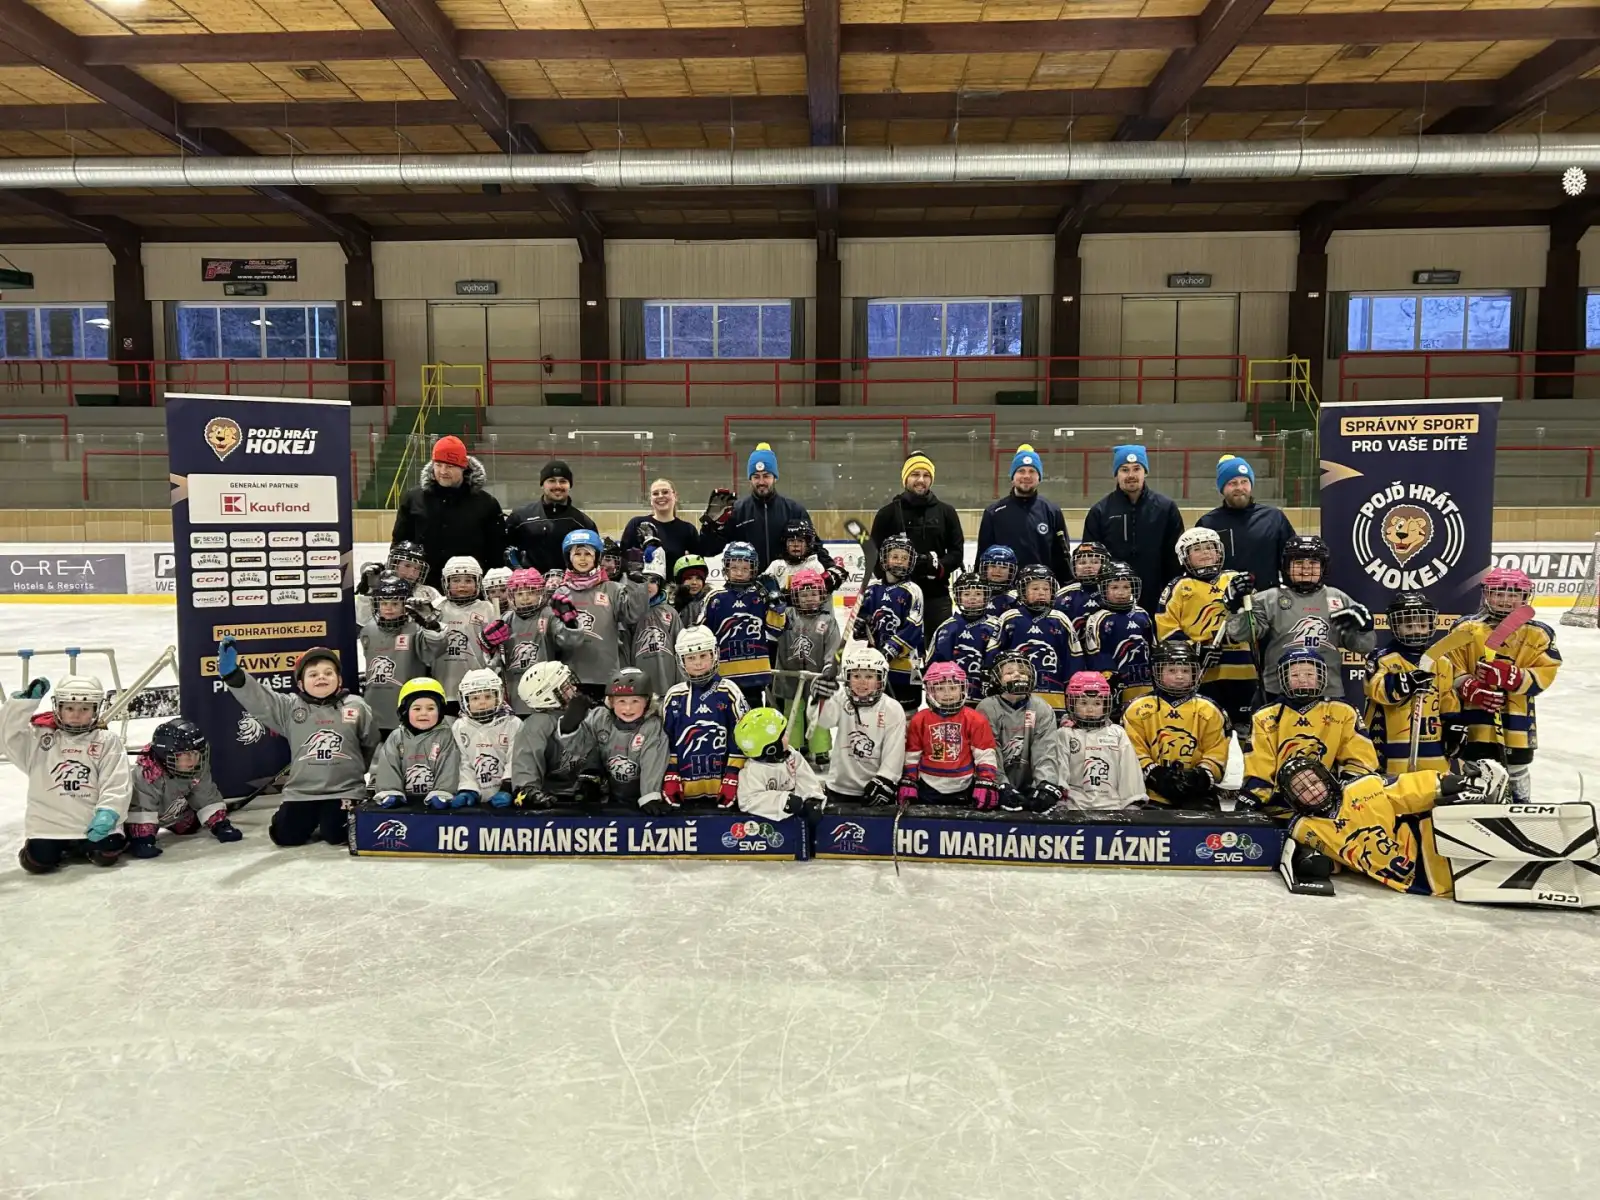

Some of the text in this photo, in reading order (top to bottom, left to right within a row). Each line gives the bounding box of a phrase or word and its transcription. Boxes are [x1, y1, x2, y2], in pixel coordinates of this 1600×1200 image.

[1345, 417, 1474, 432] SPRÁVNÝ SPORT
[248, 426, 318, 440] POJĎ HRÁT
[245, 438, 316, 455] HOKEJ
[1352, 435, 1468, 452] PRO VAŠE DÍTĚ
[1360, 480, 1460, 519] POJĎ HRÁT
[250, 502, 310, 513] Kaufland
[1364, 558, 1449, 590] HOKEJ
[13, 582, 95, 590] Hotels & Resorts
[1558, 583, 1594, 593] BODY
[217, 624, 323, 638] POJDHRATHOKEJ.CZ
[1304, 637, 1320, 647] HC
[448, 646, 461, 656] HC
[206, 654, 281, 672] SÁVNÝ
[317, 750, 332, 760] HC
[63, 780, 81, 791] HC
[413, 784, 428, 793] HC
[1508, 806, 1555, 815] CCM
[438, 819, 698, 852] HC MARIÁNSKÉ LÁZNĚ
[738, 840, 767, 851] SMS
[897, 827, 1171, 862] HC MARIÁNSKÉ LÁZNĚ
[1214, 852, 1243, 863] SMS
[1538, 892, 1580, 903] CCM
